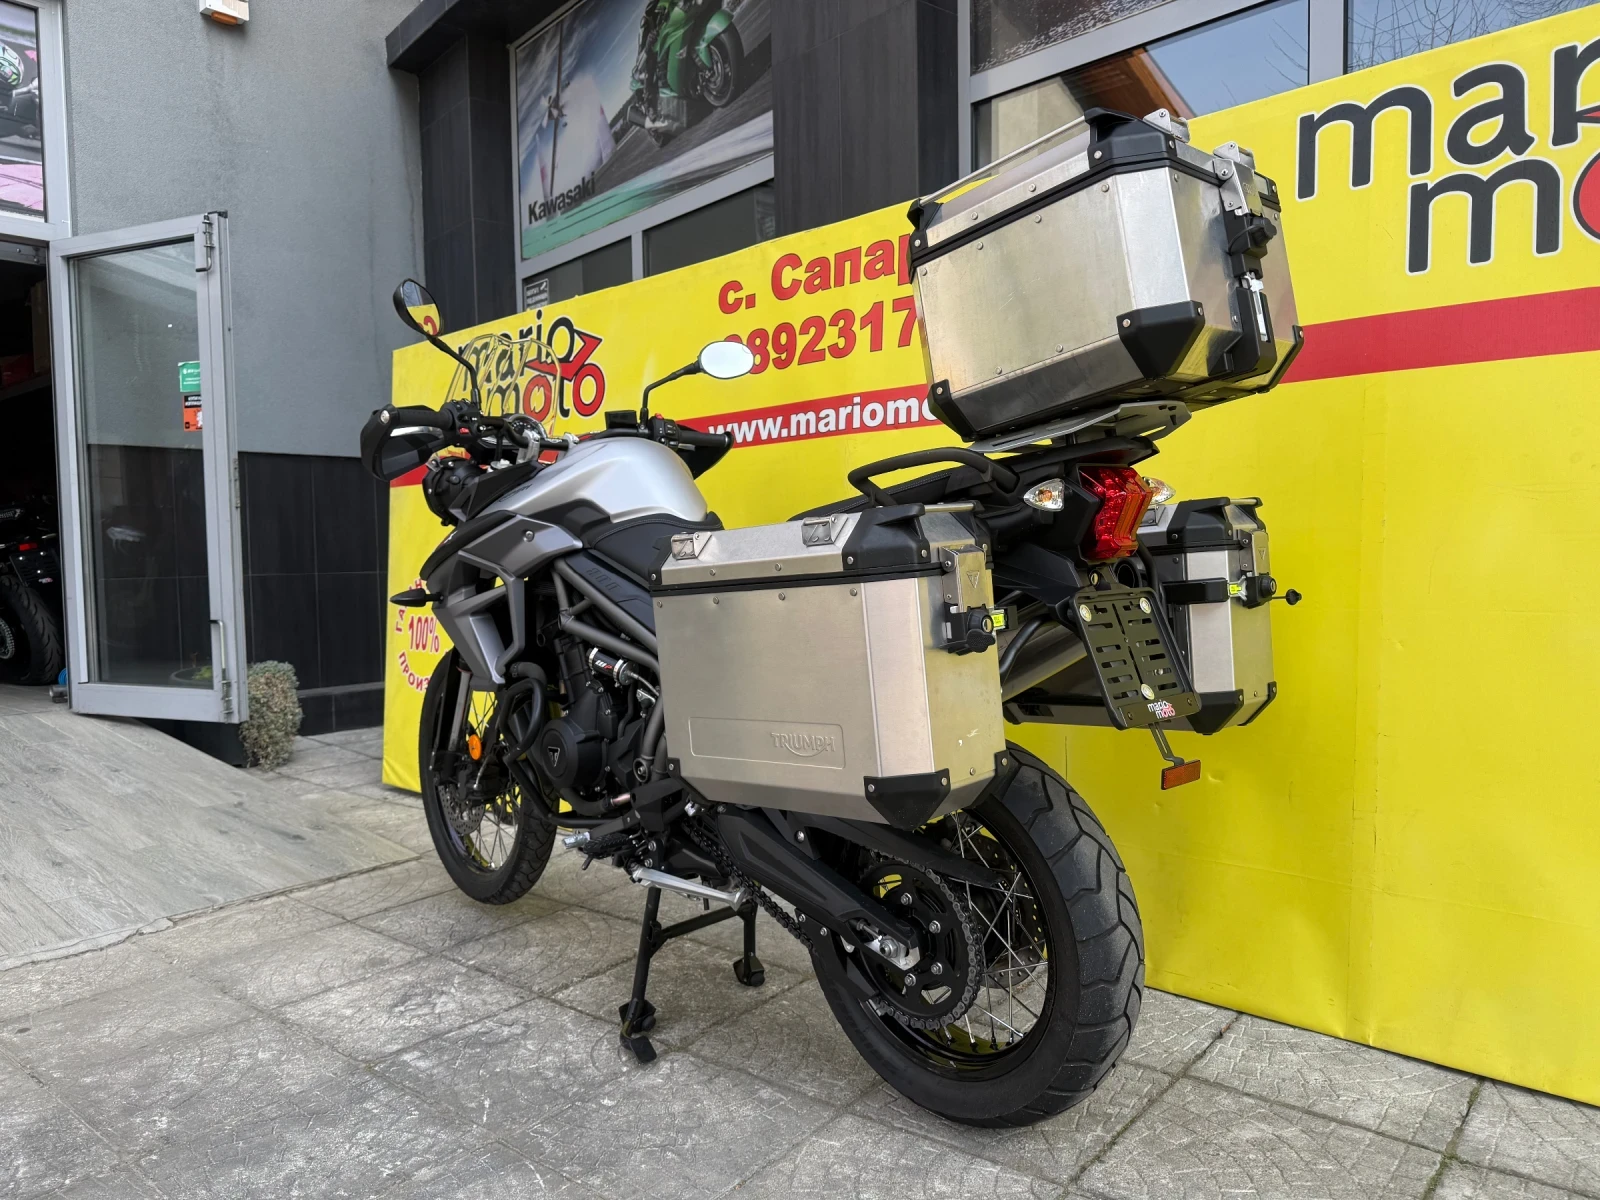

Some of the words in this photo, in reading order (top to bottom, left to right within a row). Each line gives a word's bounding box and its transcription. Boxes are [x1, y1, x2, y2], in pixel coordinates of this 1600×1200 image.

[528, 171, 595, 225] Kawasaki
[458, 309, 575, 392] mario
[724, 295, 918, 375] 892317
[485, 362, 606, 423] moto
[408, 615, 440, 653] 100%
[771, 732, 836, 757] TRIUMPH
